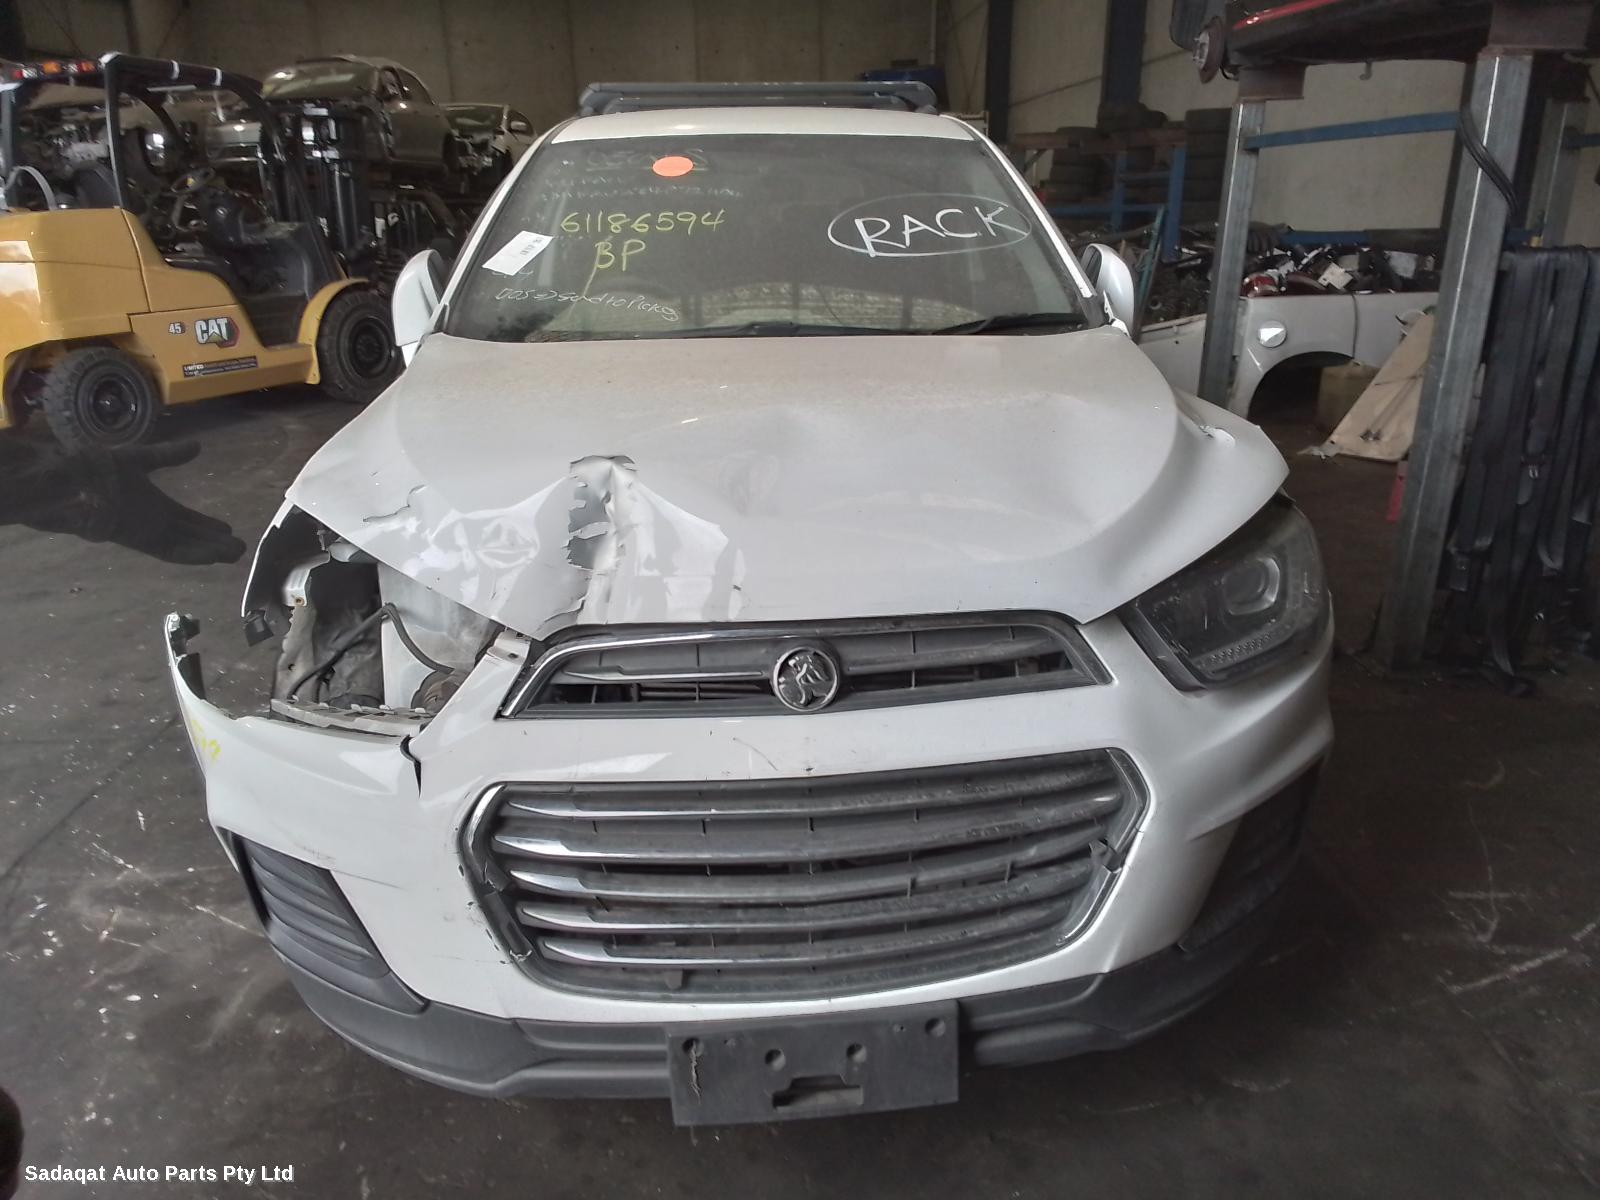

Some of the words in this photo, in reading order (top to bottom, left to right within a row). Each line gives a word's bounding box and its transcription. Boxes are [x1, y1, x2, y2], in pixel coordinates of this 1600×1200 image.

[560, 209, 725, 235] 61186594
[855, 206, 1028, 257] RACK
[594, 239, 646, 272] BP
[168, 322, 182, 334] 45
[195, 318, 229, 344] CAT
